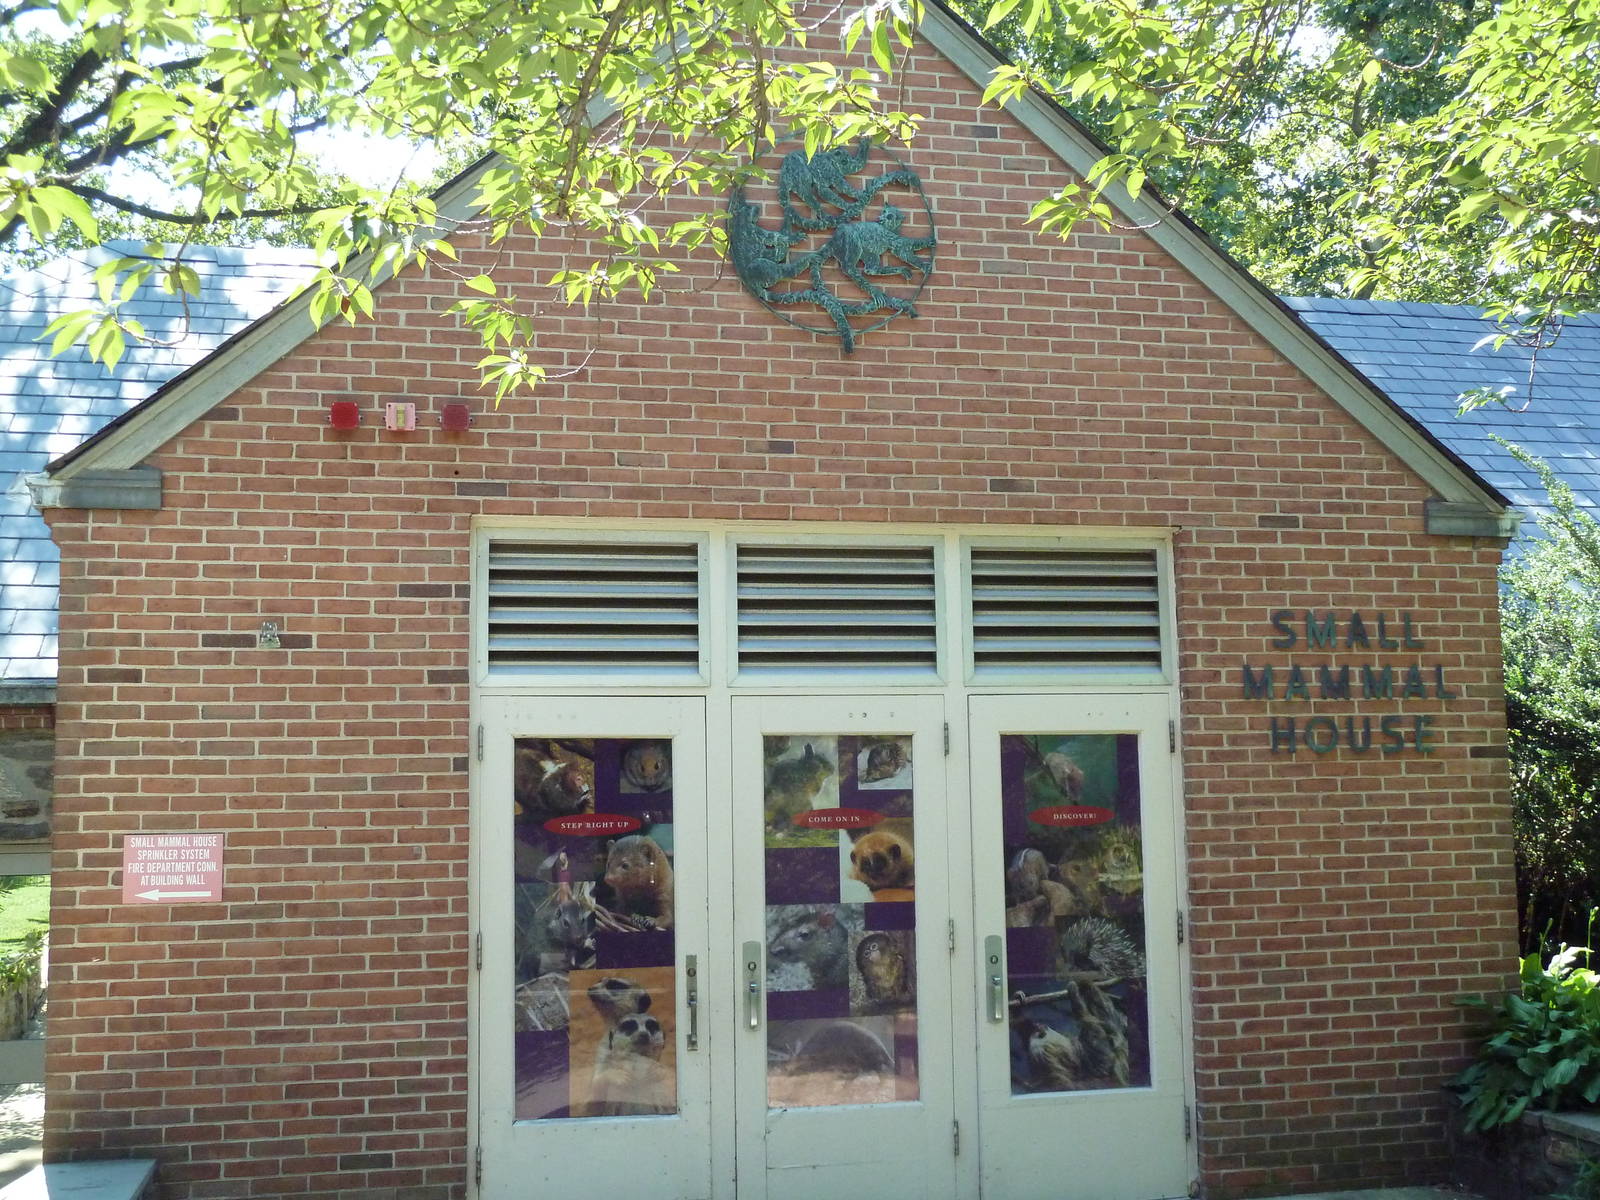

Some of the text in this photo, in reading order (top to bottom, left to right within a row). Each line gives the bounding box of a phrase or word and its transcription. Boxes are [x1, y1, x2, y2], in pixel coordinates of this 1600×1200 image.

[1272, 609, 1425, 649] SMALL
[1242, 663, 1457, 700] MAMMAL
[1271, 714, 1436, 754] HOUSE
[586, 821, 614, 829] RIGHT
[130, 836, 217, 848] SMALL MAMMAL HOUSE
[137, 849, 210, 860] SPRINKLER SYSTEM
[128, 861, 218, 873] FIRE DEPARTMENT CONN.
[140, 874, 206, 886] AT BUILDING WALL
